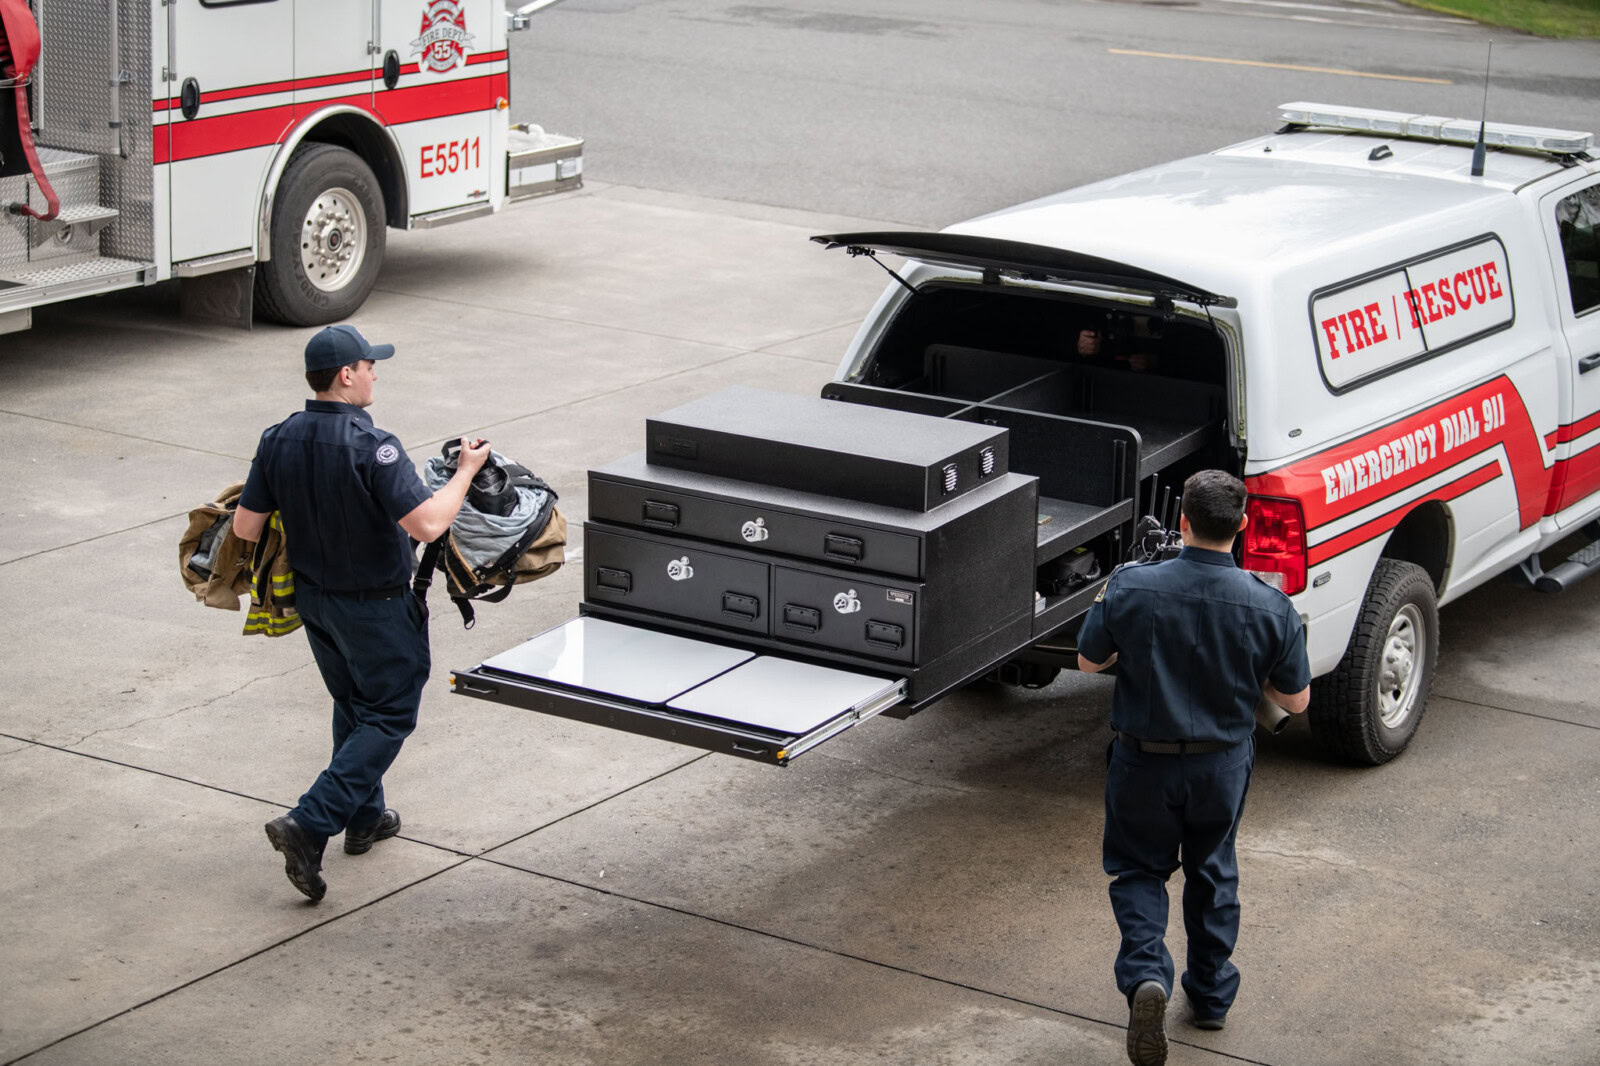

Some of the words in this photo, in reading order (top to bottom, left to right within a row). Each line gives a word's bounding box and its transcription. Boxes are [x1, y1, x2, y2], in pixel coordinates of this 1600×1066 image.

[422, 29, 440, 46] FIRE
[434, 40, 451, 59] 55
[421, 136, 480, 179] E5511
[1321, 302, 1388, 360] FIRE
[1403, 261, 1503, 329] RESCUE
[1321, 424, 1437, 505] EMERGENCY
[1440, 407, 1480, 453] DIAL
[1482, 393, 1506, 433] 911
